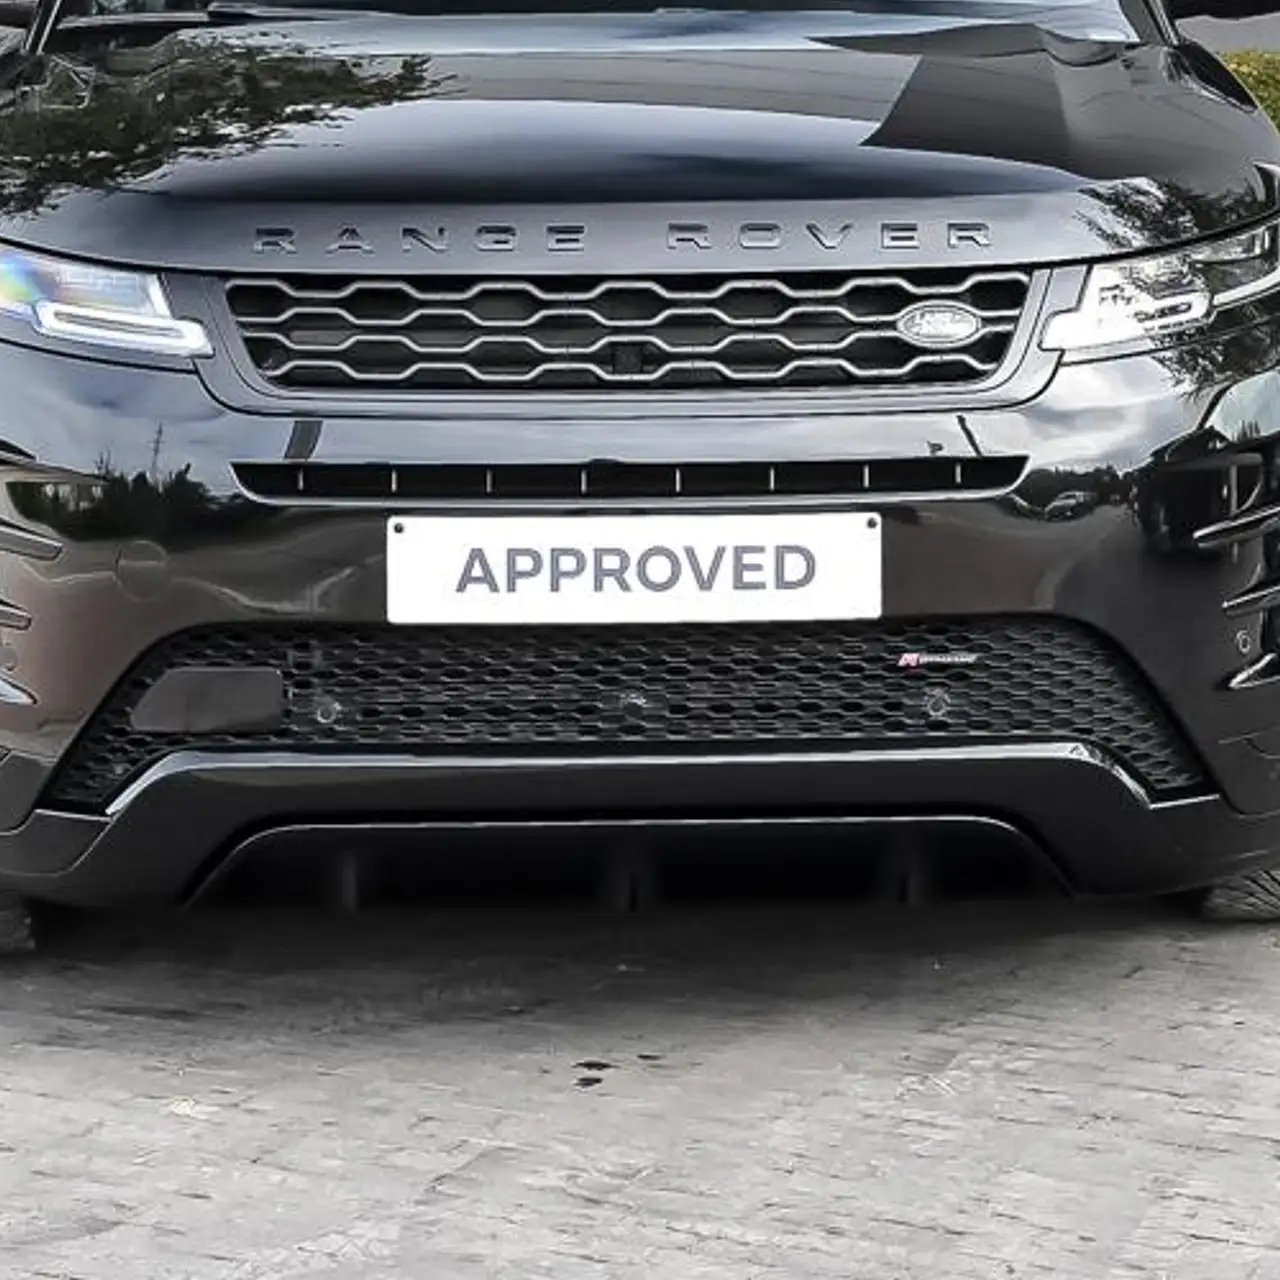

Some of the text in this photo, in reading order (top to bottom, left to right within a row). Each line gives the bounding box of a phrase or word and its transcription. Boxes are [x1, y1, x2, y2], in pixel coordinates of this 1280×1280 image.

[254, 222, 992, 254] RANGE ROVER
[456, 545, 817, 593] APPROVED
